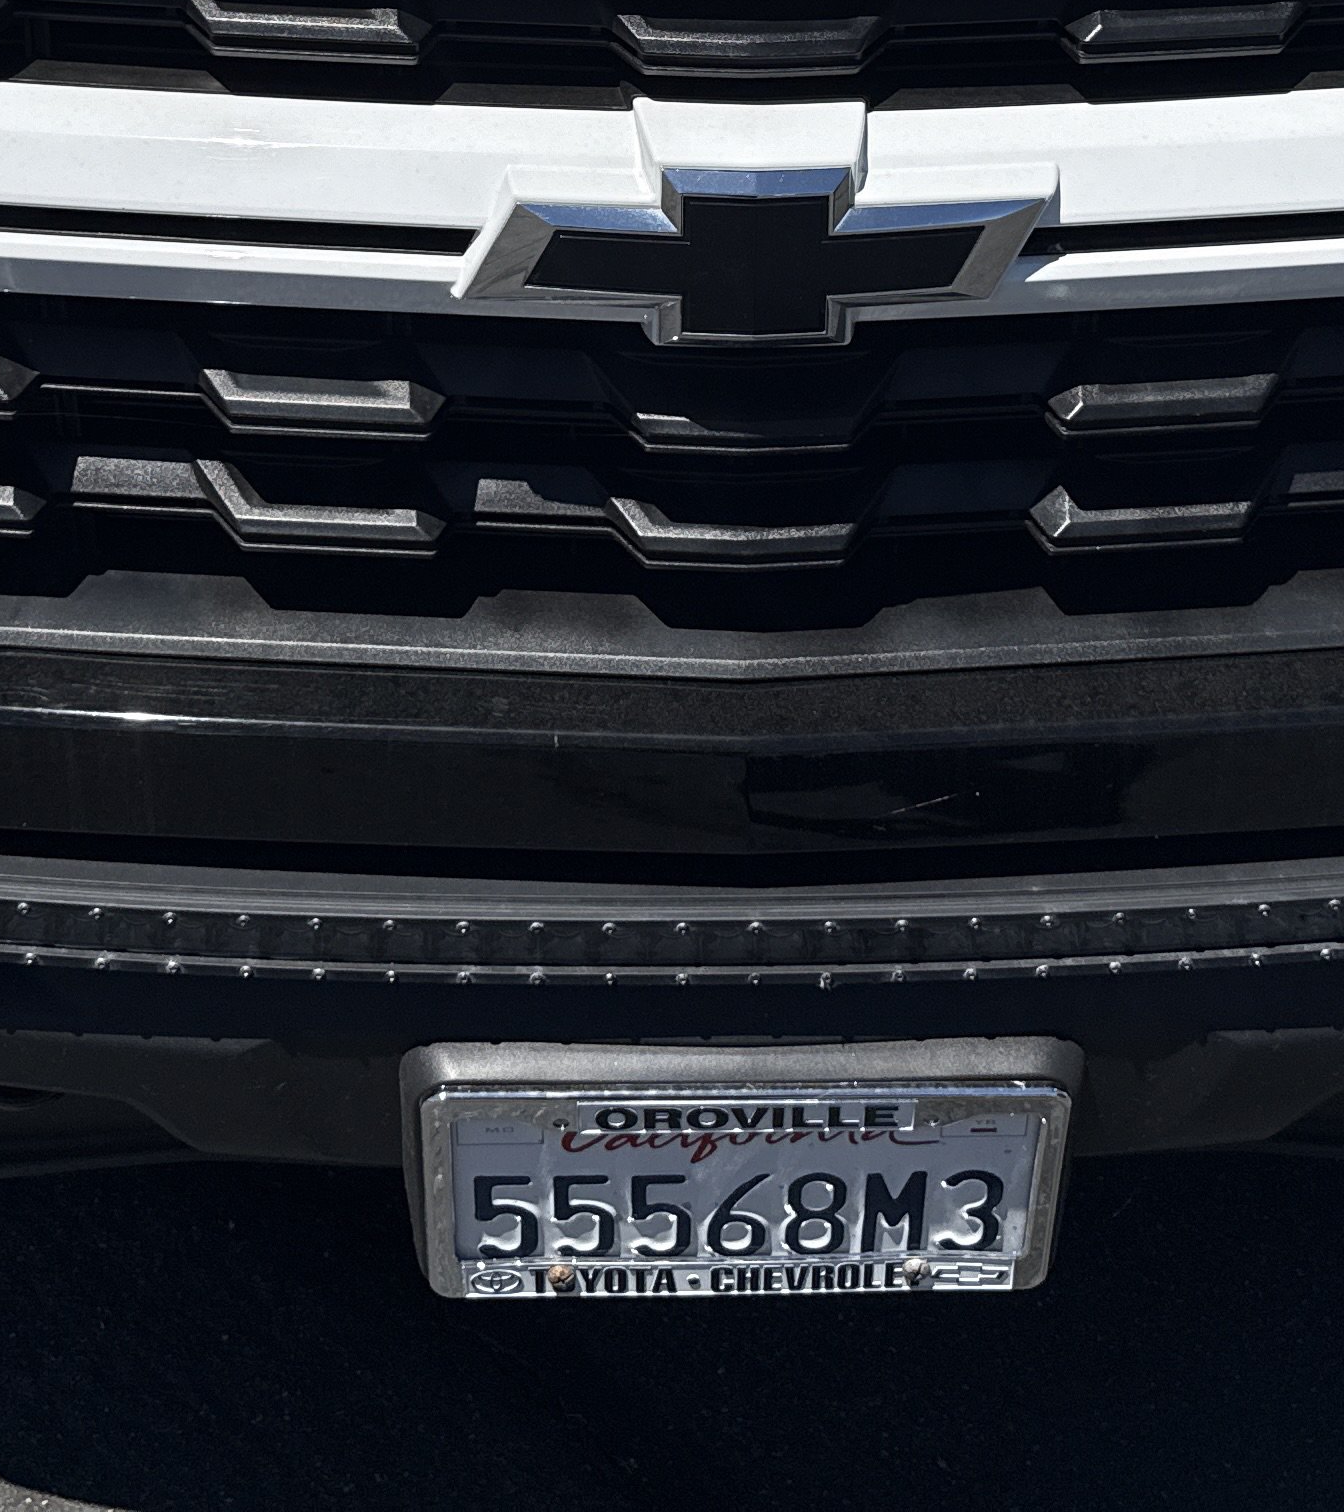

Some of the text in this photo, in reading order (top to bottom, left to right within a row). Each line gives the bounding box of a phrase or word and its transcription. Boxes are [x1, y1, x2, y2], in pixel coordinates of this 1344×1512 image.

[594, 1105, 900, 1131] OROVILLE
[472, 1169, 1005, 1258] 55568M3
[709, 1260, 922, 1293] CHEVROLE
